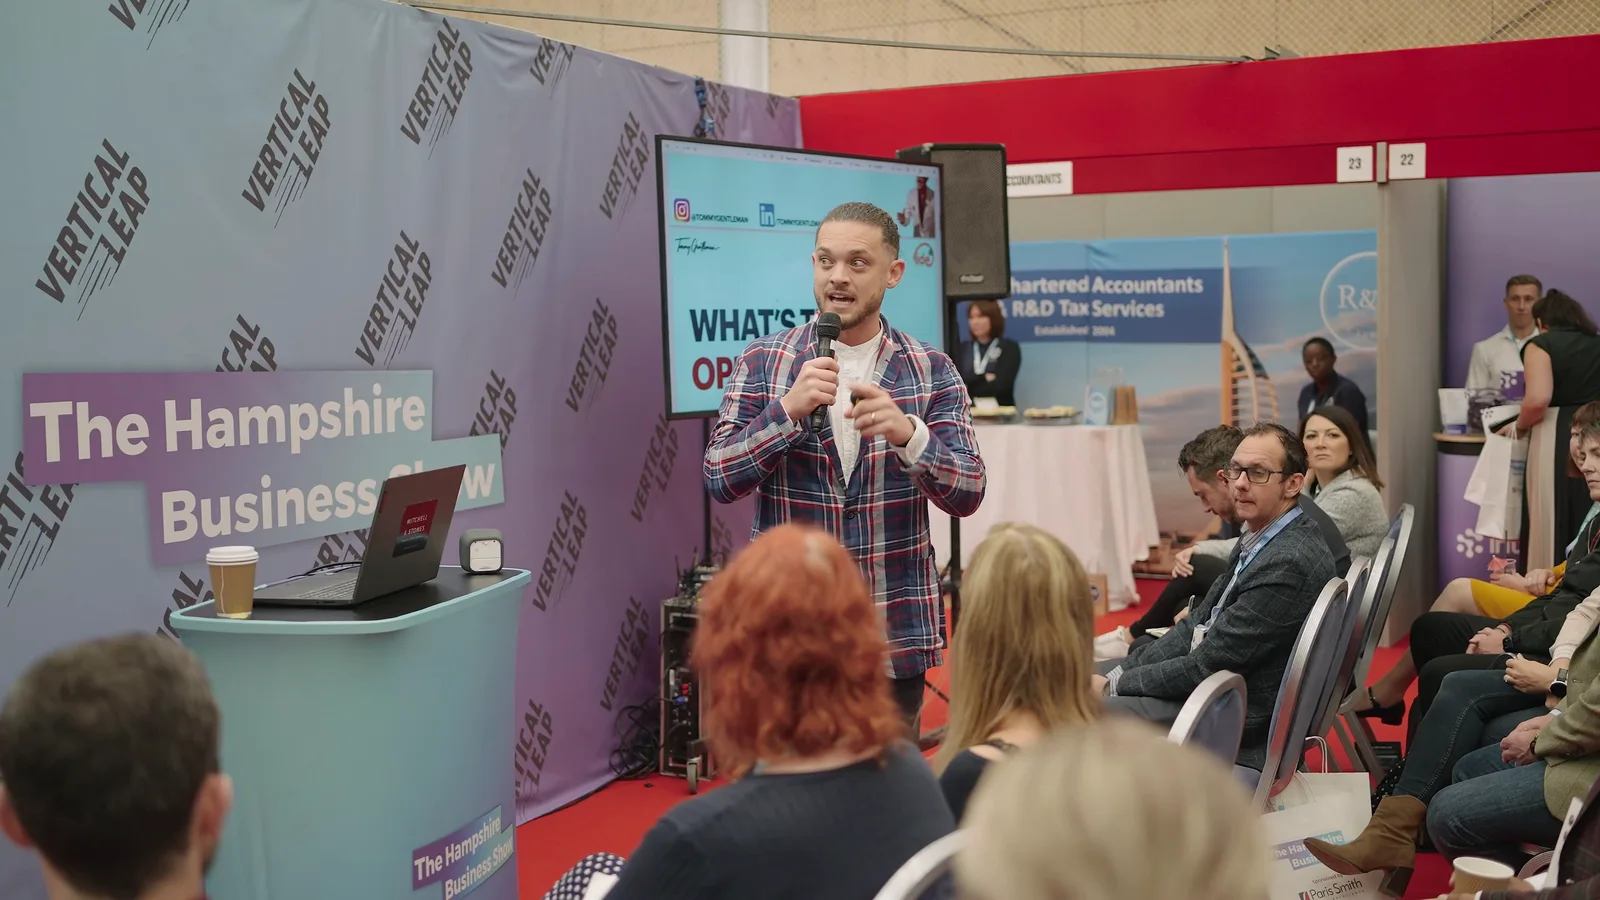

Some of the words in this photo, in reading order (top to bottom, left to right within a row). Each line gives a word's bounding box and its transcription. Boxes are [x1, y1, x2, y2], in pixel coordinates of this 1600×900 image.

[400, 17, 460, 145] VERTICAL
[441, 40, 474, 120] LEAP
[241, 67, 316, 212] VERTICAL
[288, 93, 331, 183] LEAP
[599, 110, 640, 220] VERTICAL
[626, 130, 650, 196] LEAP
[1348, 157, 1362, 170] 23
[1400, 153, 1414, 166] 22
[97, 166, 151, 265] LEAP
[1006, 172, 1063, 187] CCOUNTANTS
[35, 138, 130, 304] VERTICAL
[491, 167, 541, 289] VERTICAL
[521, 186, 553, 262] LEAP
[355, 230, 420, 367] VERTICAL
[398, 251, 432, 333] LEAP
[1011, 274, 1090, 295] hartered
[1092, 276, 1204, 294] Accountants
[1012, 299, 1055, 318] R&D
[1058, 299, 1090, 317] Tax
[1092, 299, 1165, 318] Services
[564, 297, 609, 413] VERTICAL
[593, 314, 619, 384] LEAP
[29, 400, 150, 462] The
[164, 382, 426, 455] Hampshire
[161, 473, 378, 544] Business
[561, 503, 588, 577] LEAP
[532, 488, 578, 612] VERTICAL
[600, 595, 642, 712] VERTICAL
[414, 854, 443, 880] The
[445, 817, 500, 867] Hampshire
[445, 857, 492, 900] Business
[493, 836, 514, 866] Show
[1310, 888, 1334, 900] Paris
[1332, 879, 1363, 894] Smith
